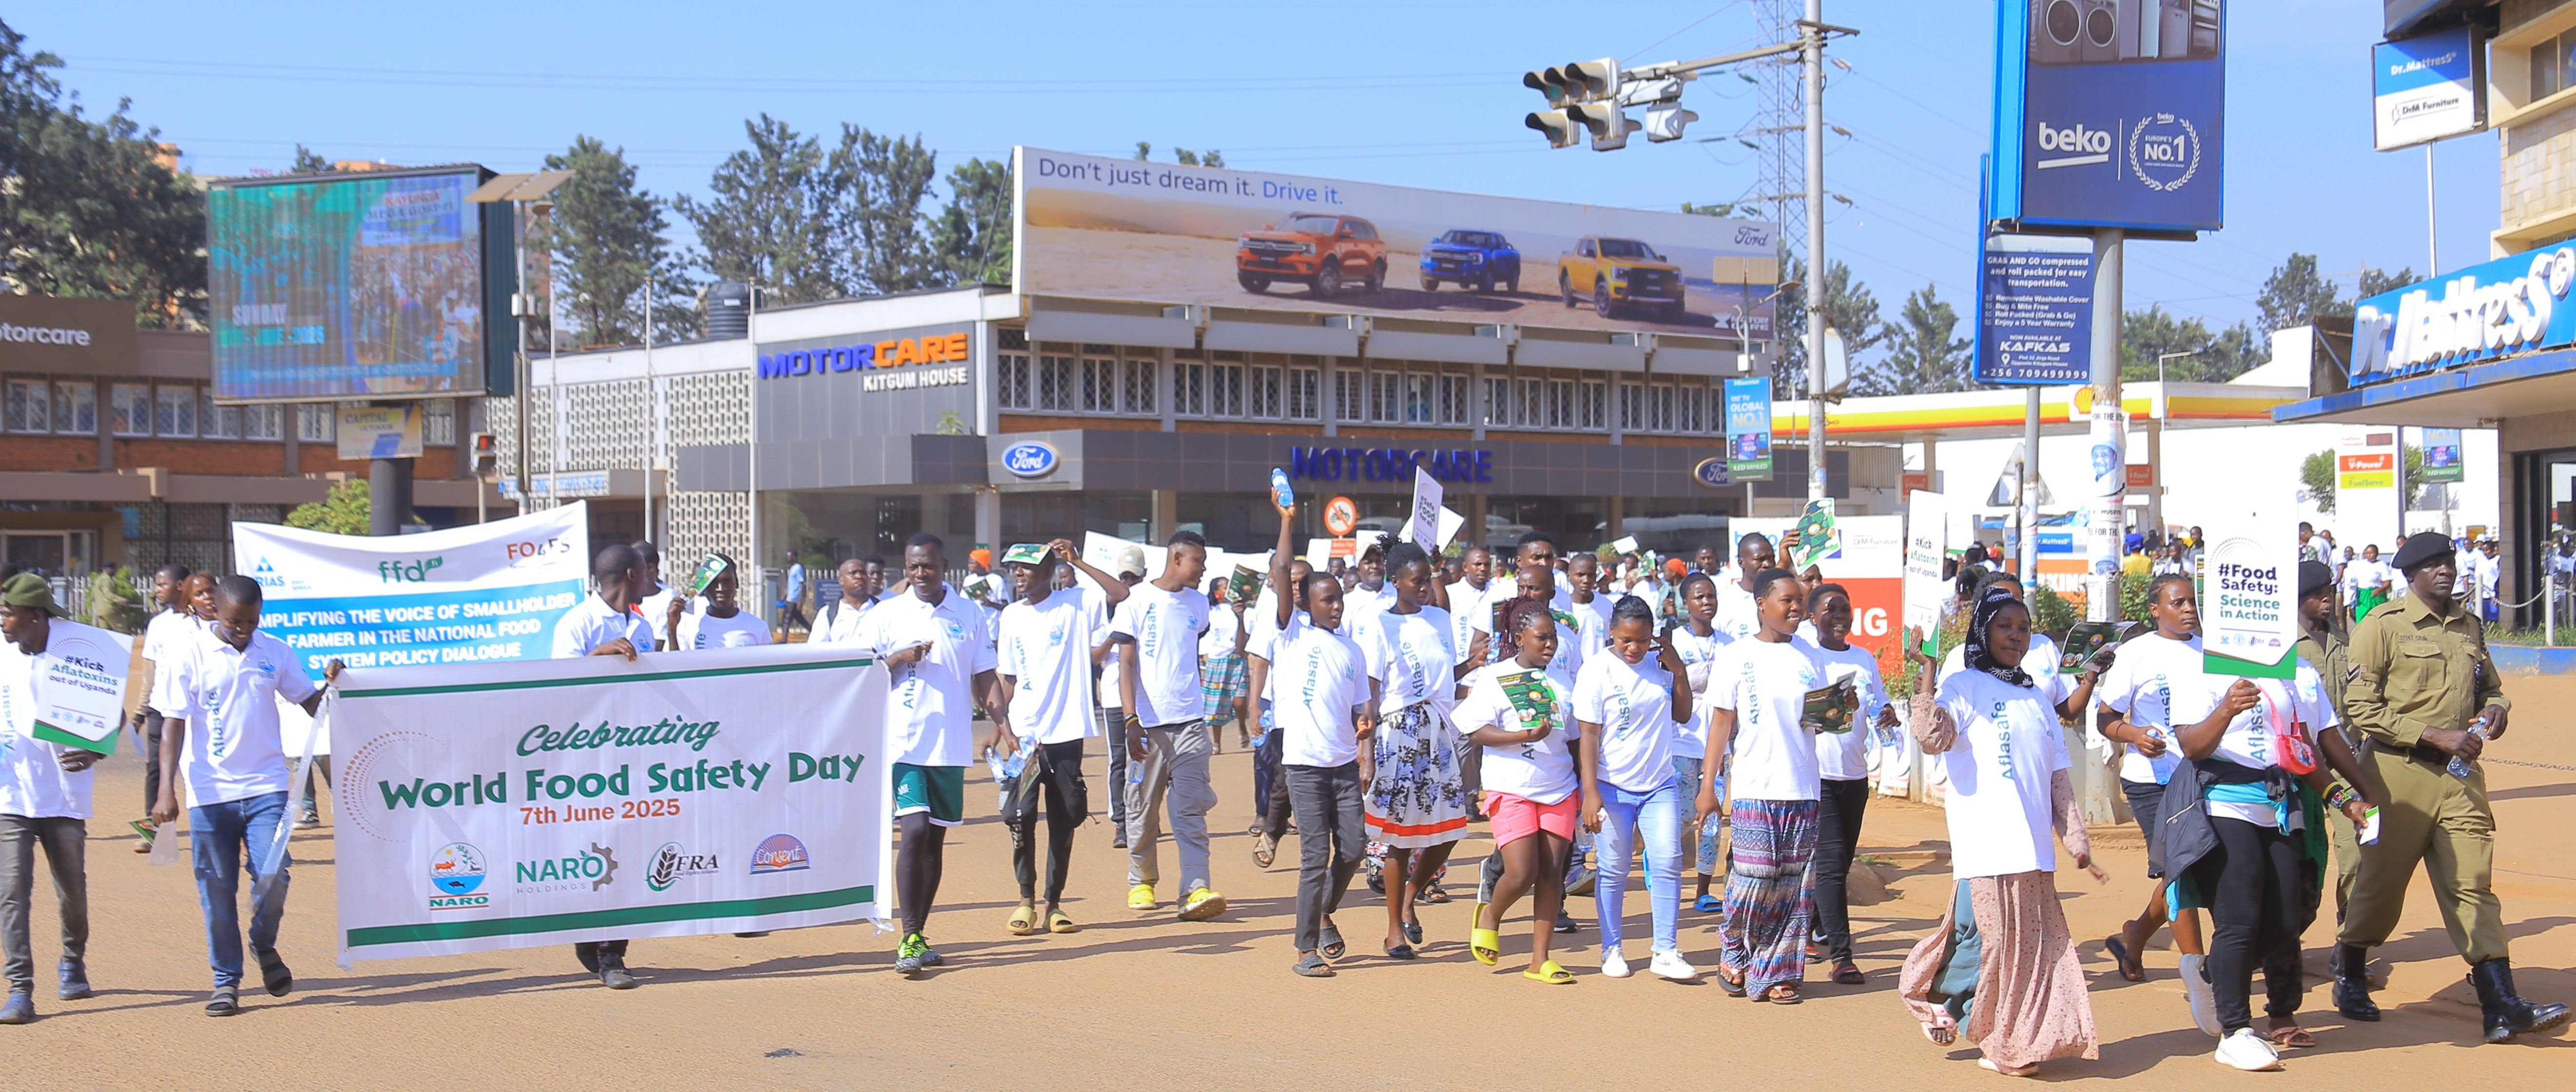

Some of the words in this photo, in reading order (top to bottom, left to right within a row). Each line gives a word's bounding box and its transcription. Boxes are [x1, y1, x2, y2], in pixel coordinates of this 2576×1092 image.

[2422, 98, 2459, 110] Furniture
[2157, 112, 2174, 121] beko
[2038, 121, 2111, 153] beko
[1108, 164, 1151, 186] just
[1159, 171, 1227, 194] dream
[1236, 177, 1255, 196] it.
[1262, 180, 1317, 202] Drive
[1324, 185, 1343, 205] it.
[1734, 225, 1769, 247] Ford
[2042, 257, 2089, 268] compressed
[2008, 267, 2021, 275] roll
[2024, 268, 2053, 277] packed
[2054, 268, 2067, 278] for
[2069, 270, 2087, 278] easy
[232, 304, 287, 326] SUNDAY
[2043, 320, 2075, 329] Warranty
[0, 322, 91, 347] torcare
[758, 333, 968, 379] MOTORCARE
[1999, 341, 2071, 352] KAFKAS
[863, 370, 916, 391] KITGUM
[919, 367, 968, 387] HOUSE
[1990, 368, 2012, 377] 256
[1730, 402, 1765, 412] GLOBAL
[345, 413, 387, 425] CAPITAL
[1733, 411, 1764, 427] NO.1
[1012, 448, 1045, 469] Ford
[1291, 446, 1493, 483] MOTORCARE
[2348, 460, 2383, 469] V-Power
[1707, 463, 1729, 482] For
[1419, 502, 1435, 523] Food
[1420, 495, 1434, 511] #Safe
[1916, 536, 1932, 550] #Kick
[1910, 550, 1938, 565] Aflatoxins
[253, 575, 285, 587] RIAS
[378, 560, 426, 584] ffd
[1922, 568, 1937, 578] Uganda
[2219, 563, 2277, 581] #Food
[2221, 578, 2278, 596] Safety:
[258, 610, 345, 629] MPLIFYING
[349, 609, 382, 624] THE
[384, 606, 435, 623] VOICE
[437, 604, 460, 619] OF
[463, 592, 576, 618] SMALLHOLDER
[2220, 593, 2280, 610] Science
[2220, 606, 2232, 618] in
[2235, 609, 2278, 622] Action
[287, 631, 355, 648] FARMER
[359, 630, 376, 645] IN
[379, 629, 412, 645] THE
[414, 623, 497, 643] NATIONAL
[499, 618, 542, 637] FOOD
[1145, 603, 1156, 658] Aflasafe
[1458, 616, 1468, 658] Aflasafe
[379, 648, 439, 665] POLICY
[442, 642, 522, 662] DIALOGUE
[64, 655, 105, 672] #Kick
[1402, 641, 1423, 698] Aflasafe
[50, 663, 119, 686] Aflatoxins
[1302, 646, 1321, 710] Aflasafe
[49, 674, 66, 683] out
[78, 680, 117, 696] Uganda
[516, 714, 721, 757] Celebrating
[378, 771, 507, 810] World
[525, 764, 629, 801] Food
[647, 759, 772, 793] Safety
[788, 752, 866, 784] Day
[520, 806, 557, 825] 7th
[563, 804, 616, 823] June
[621, 798, 681, 819] 2025
[675, 854, 720, 871] FRA
[755, 845, 802, 864] Consent
[516, 856, 603, 884] NARO
[516, 882, 587, 894] HOLDINGS
[429, 896, 489, 907] NARO
